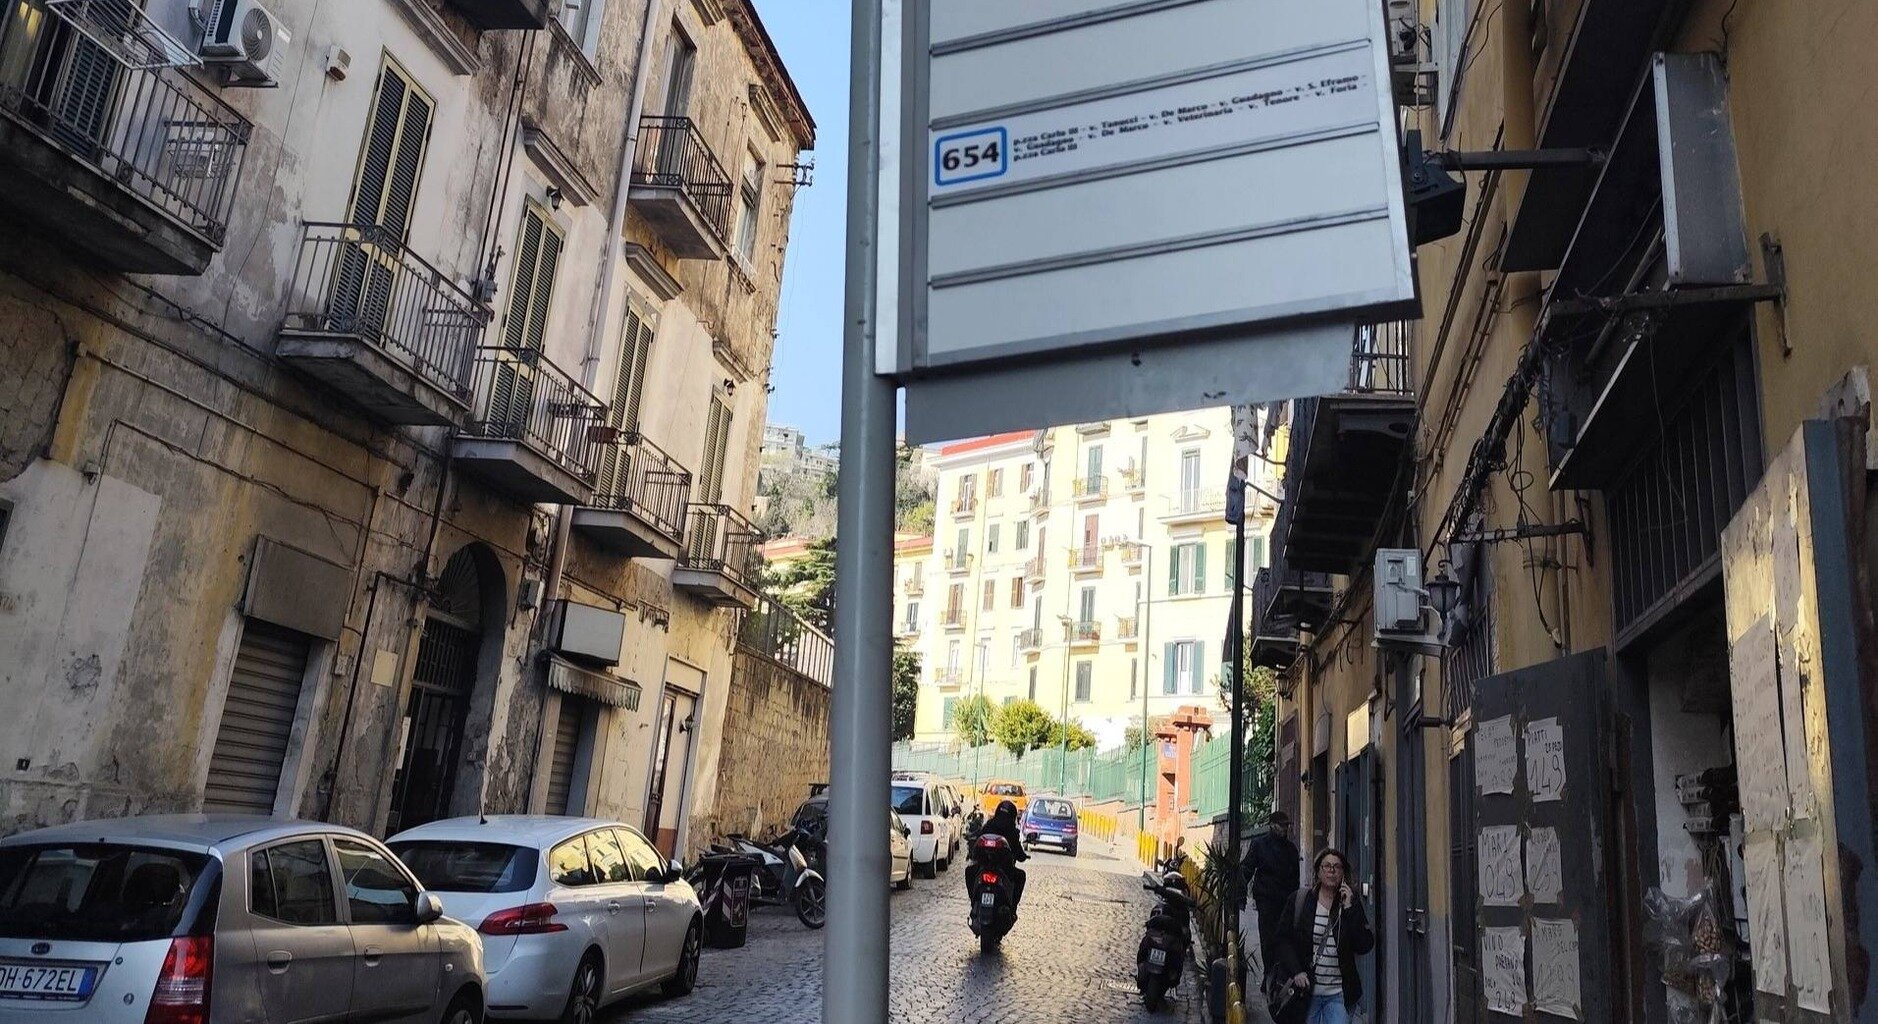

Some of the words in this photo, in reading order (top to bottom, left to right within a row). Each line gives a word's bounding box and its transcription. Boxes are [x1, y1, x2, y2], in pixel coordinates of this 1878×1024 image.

[1177, 106, 1234, 123] Veterinaria
[1330, 84, 1358, 95] Foria
[1041, 129, 1066, 140] Carlo
[1101, 115, 1138, 129] Tanucci
[942, 141, 999, 171] 654
[1041, 145, 1066, 157] Carlo
